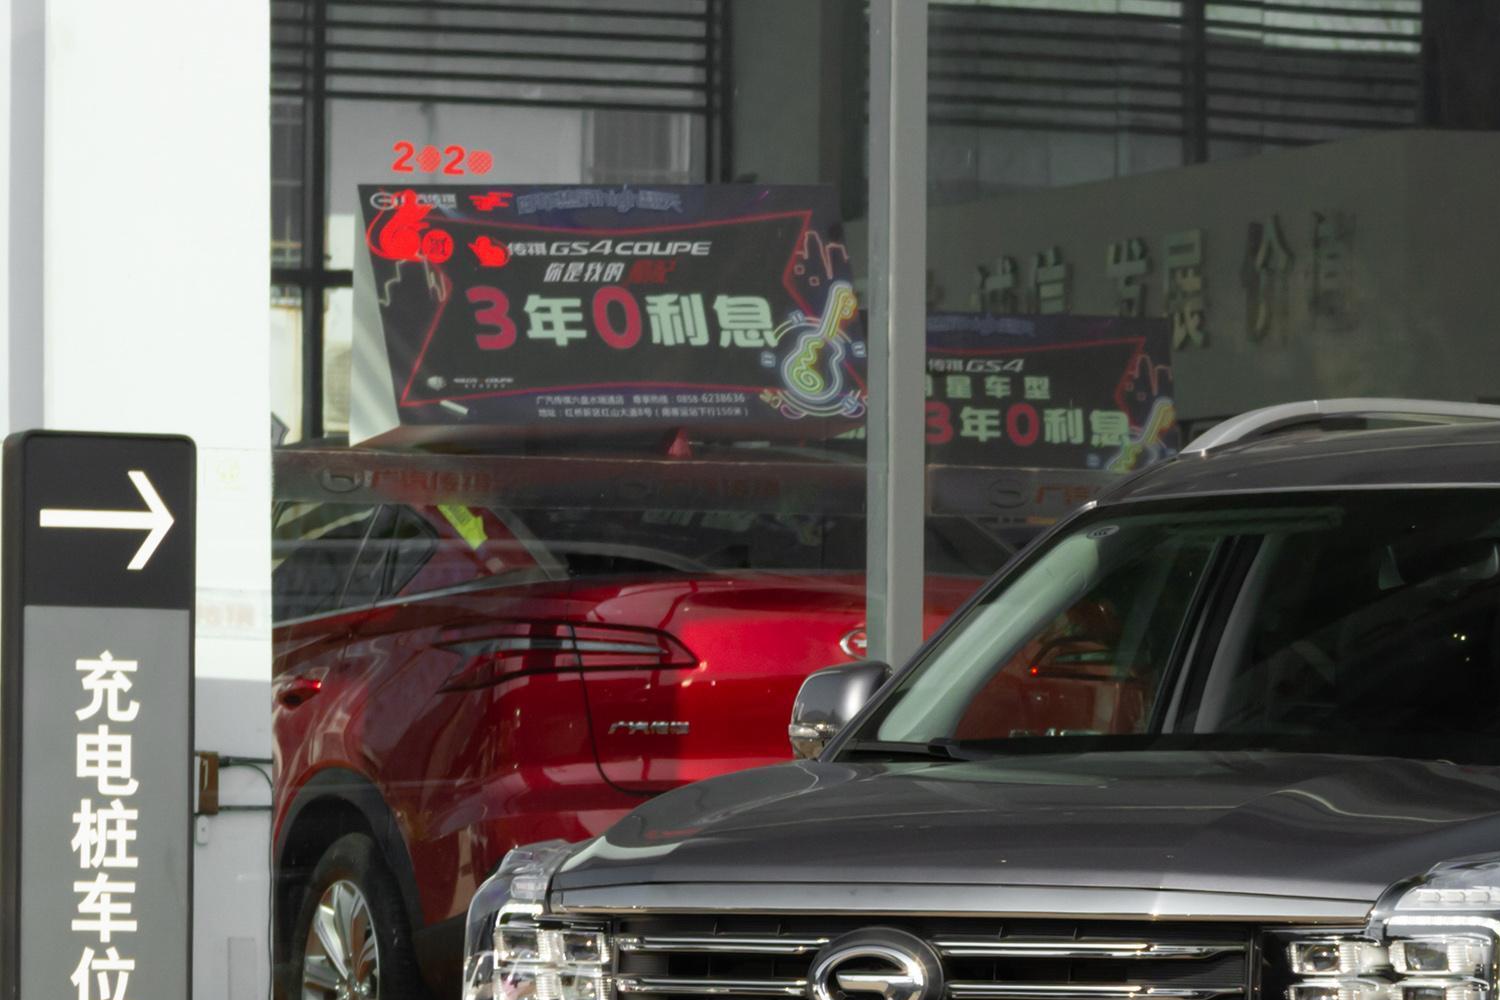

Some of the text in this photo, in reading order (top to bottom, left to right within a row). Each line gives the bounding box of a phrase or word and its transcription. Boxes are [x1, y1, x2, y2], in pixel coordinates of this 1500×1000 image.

[543, 261, 626, 283] 你是我的
[465, 285, 778, 350] 3年0利息
[925, 401, 1130, 447] 3年0利息
